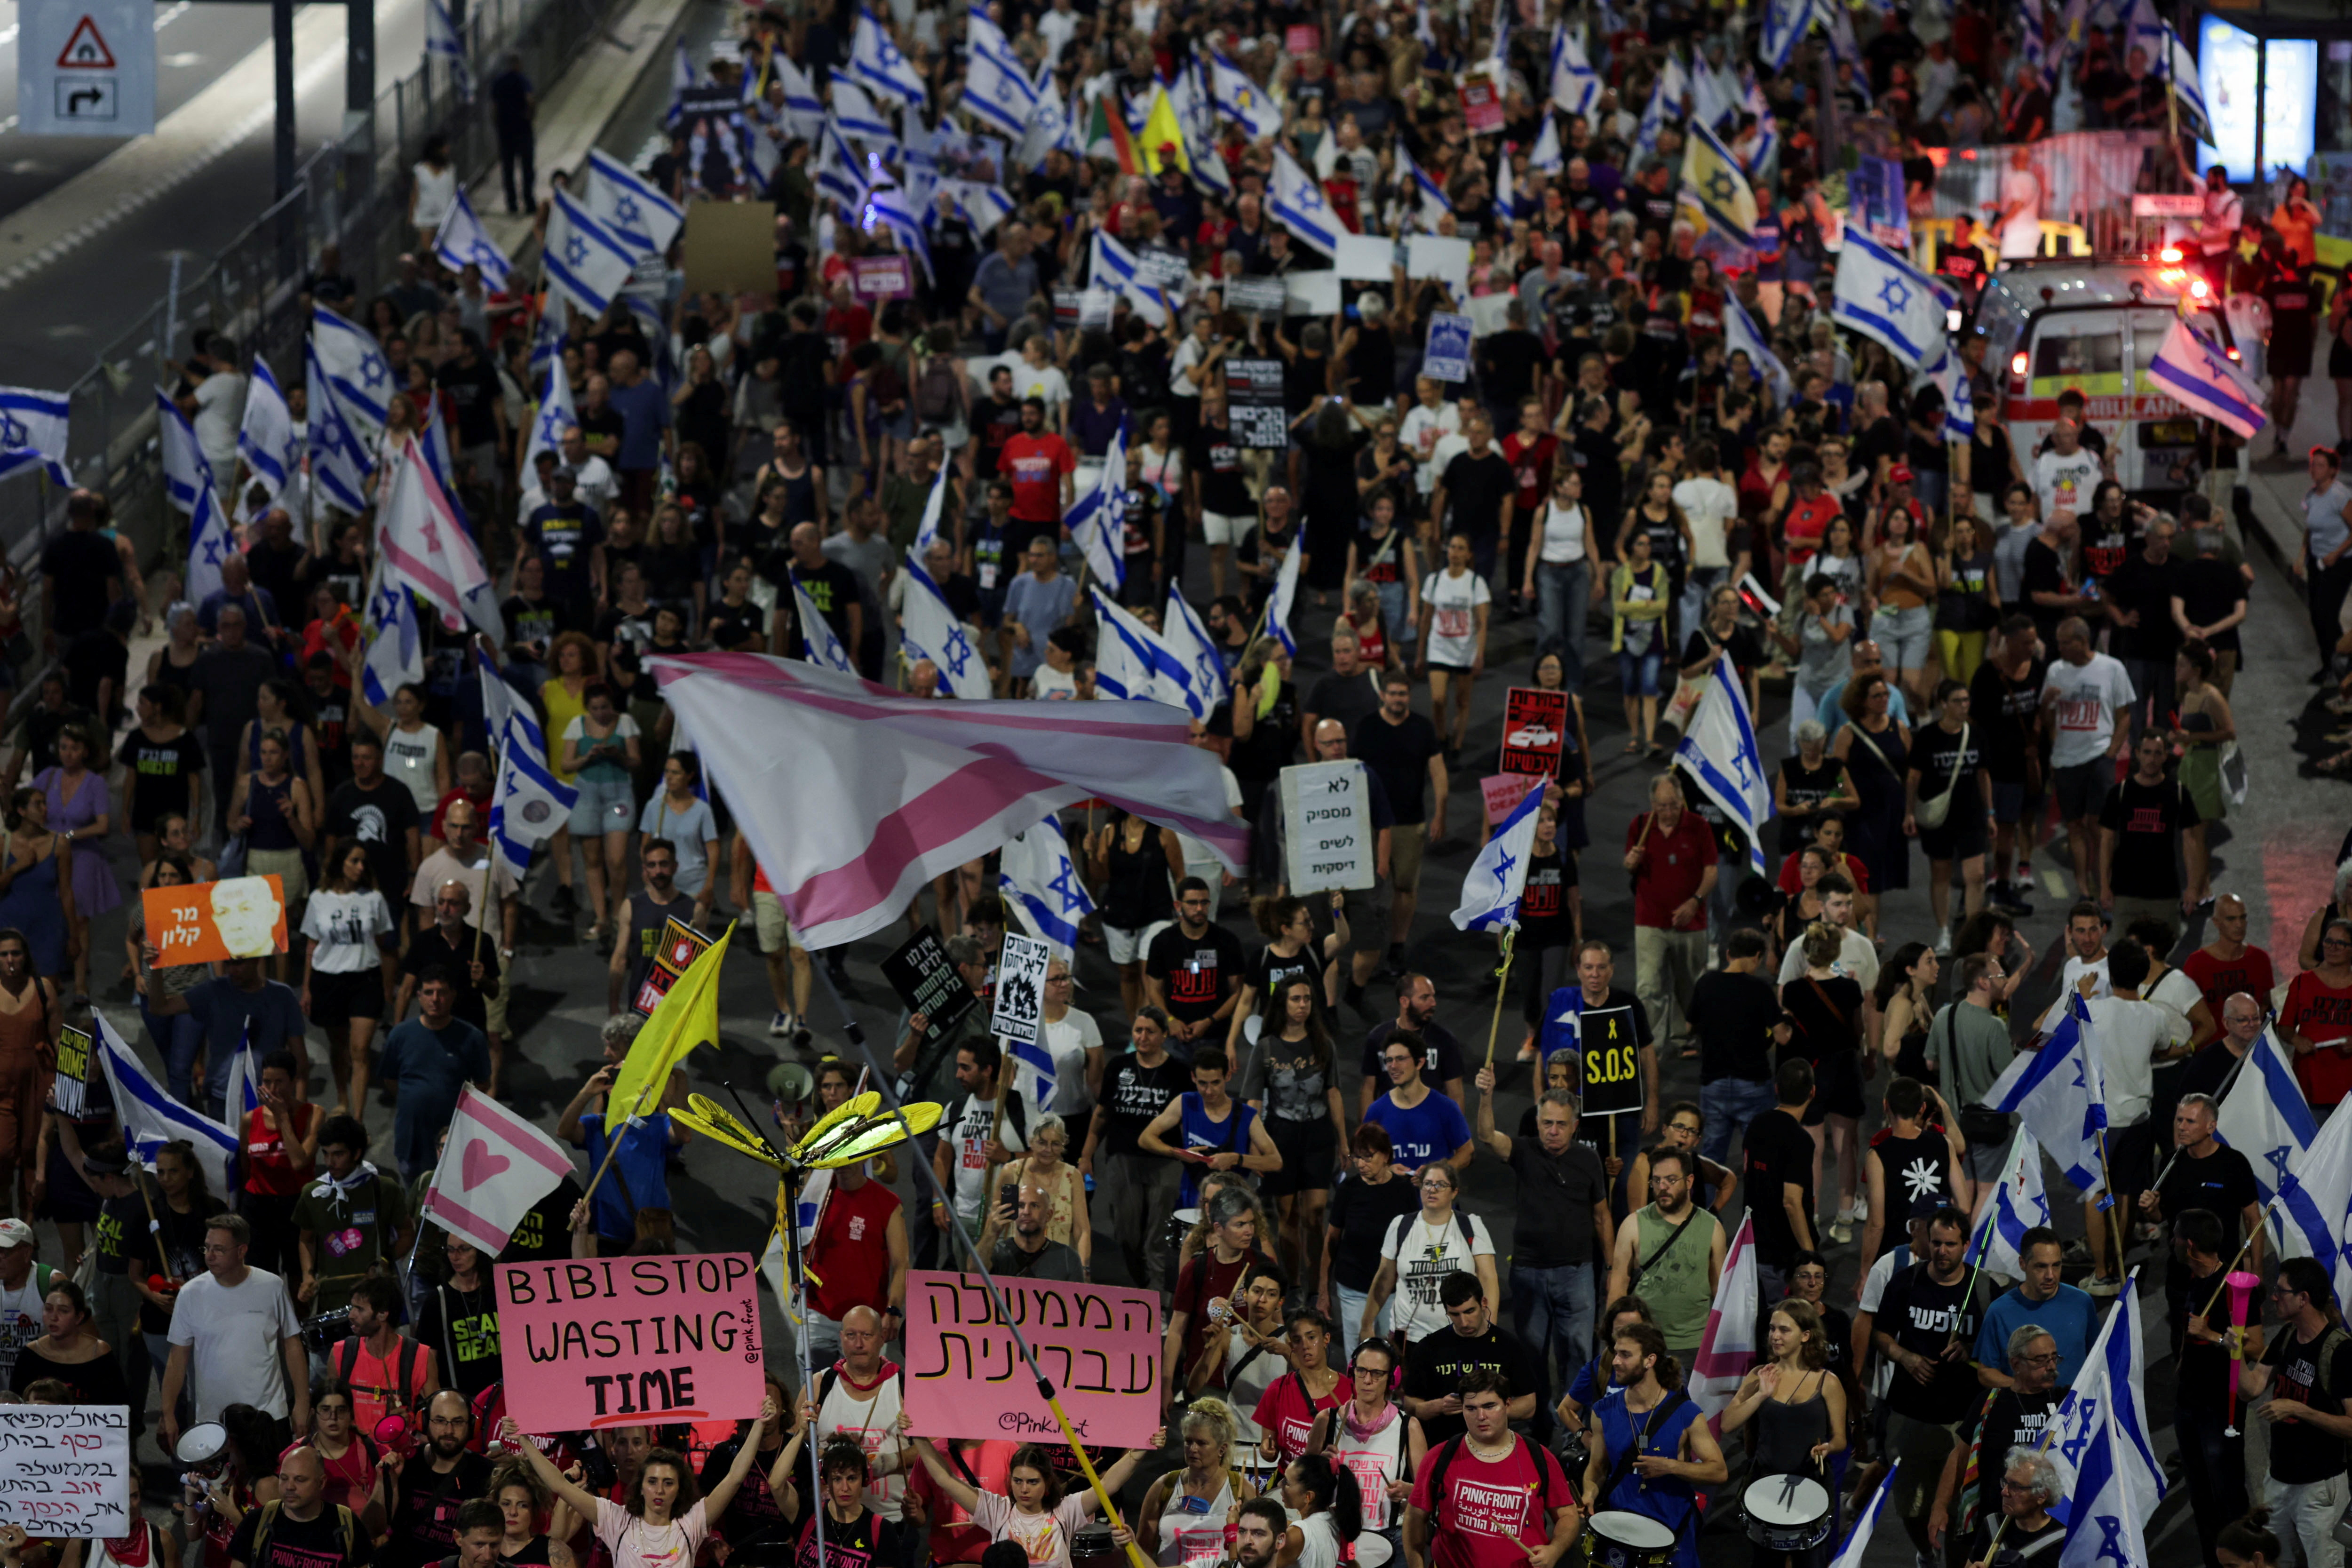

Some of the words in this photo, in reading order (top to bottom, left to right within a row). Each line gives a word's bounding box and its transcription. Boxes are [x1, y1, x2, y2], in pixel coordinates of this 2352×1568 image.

[1504, 750, 1558, 773] עכשיו!
[1328, 776, 1350, 793] לא
[1306, 806, 1351, 824] מספיק
[1319, 835, 1354, 850] לשים
[1311, 860, 1356, 875] דיסקית
[171, 907, 199, 923] מר
[161, 924, 201, 950] קלון
[918, 935, 936, 956] אין
[1006, 935, 1033, 956] שהרס
[905, 947, 926, 967] לנו
[1004, 951, 1024, 969] יתקן
[1033, 942, 1049, 961] מי
[918, 948, 942, 977] ילדים
[1024, 958, 1045, 975] לא
[913, 962, 953, 1004] למלחמות
[944, 975, 963, 993] בלי
[57, 1043, 87, 1081] HOME
[1586, 1045, 1636, 1084] S.O.S
[55, 1072, 84, 1119] NOW!
[1114, 1106, 1159, 1117] באוקטובר
[961, 1125, 991, 1140] ראש
[507, 1259, 616, 1305] BIBI
[634, 1257, 748, 1297] STOP
[925, 1273, 1153, 1334] הממשלה
[1908, 1303, 1974, 1336] חופשי
[525, 1310, 738, 1363] WASTING
[745, 1297, 763, 1364] @pink.front
[915, 1332, 1156, 1395] עבריינית
[584, 1366, 694, 1416] TIME
[0, 1407, 127, 1429] באולימפיאד
[0, 1433, 56, 1452] בהת
[1286, 1424, 1310, 1444] PINK
[2013, 1427, 2038, 1443] ללות
[60, 1433, 102, 1458] כסף
[16, 1459, 118, 1477] בממשלה
[1348, 1459, 1370, 1469] שלם
[1370, 1460, 1384, 1470] דור
[0, 1479, 53, 1493] בהת
[61, 1480, 102, 1496] זהב
[1359, 1488, 1380, 1504] עת
[1459, 1486, 1523, 1510] PINKFRONT
[18, 1500, 79, 1521] הכסף
[85, 1502, 125, 1518] את
[1458, 1501, 1489, 1517] الوردية
[1491, 1508, 1520, 1522] الجبهة
[1458, 1513, 1488, 1531] הורודה
[1185, 1537, 1206, 1548] שלם
[1207, 1537, 1222, 1548] דור
[805, 1543, 862, 1568] PINFRONT
